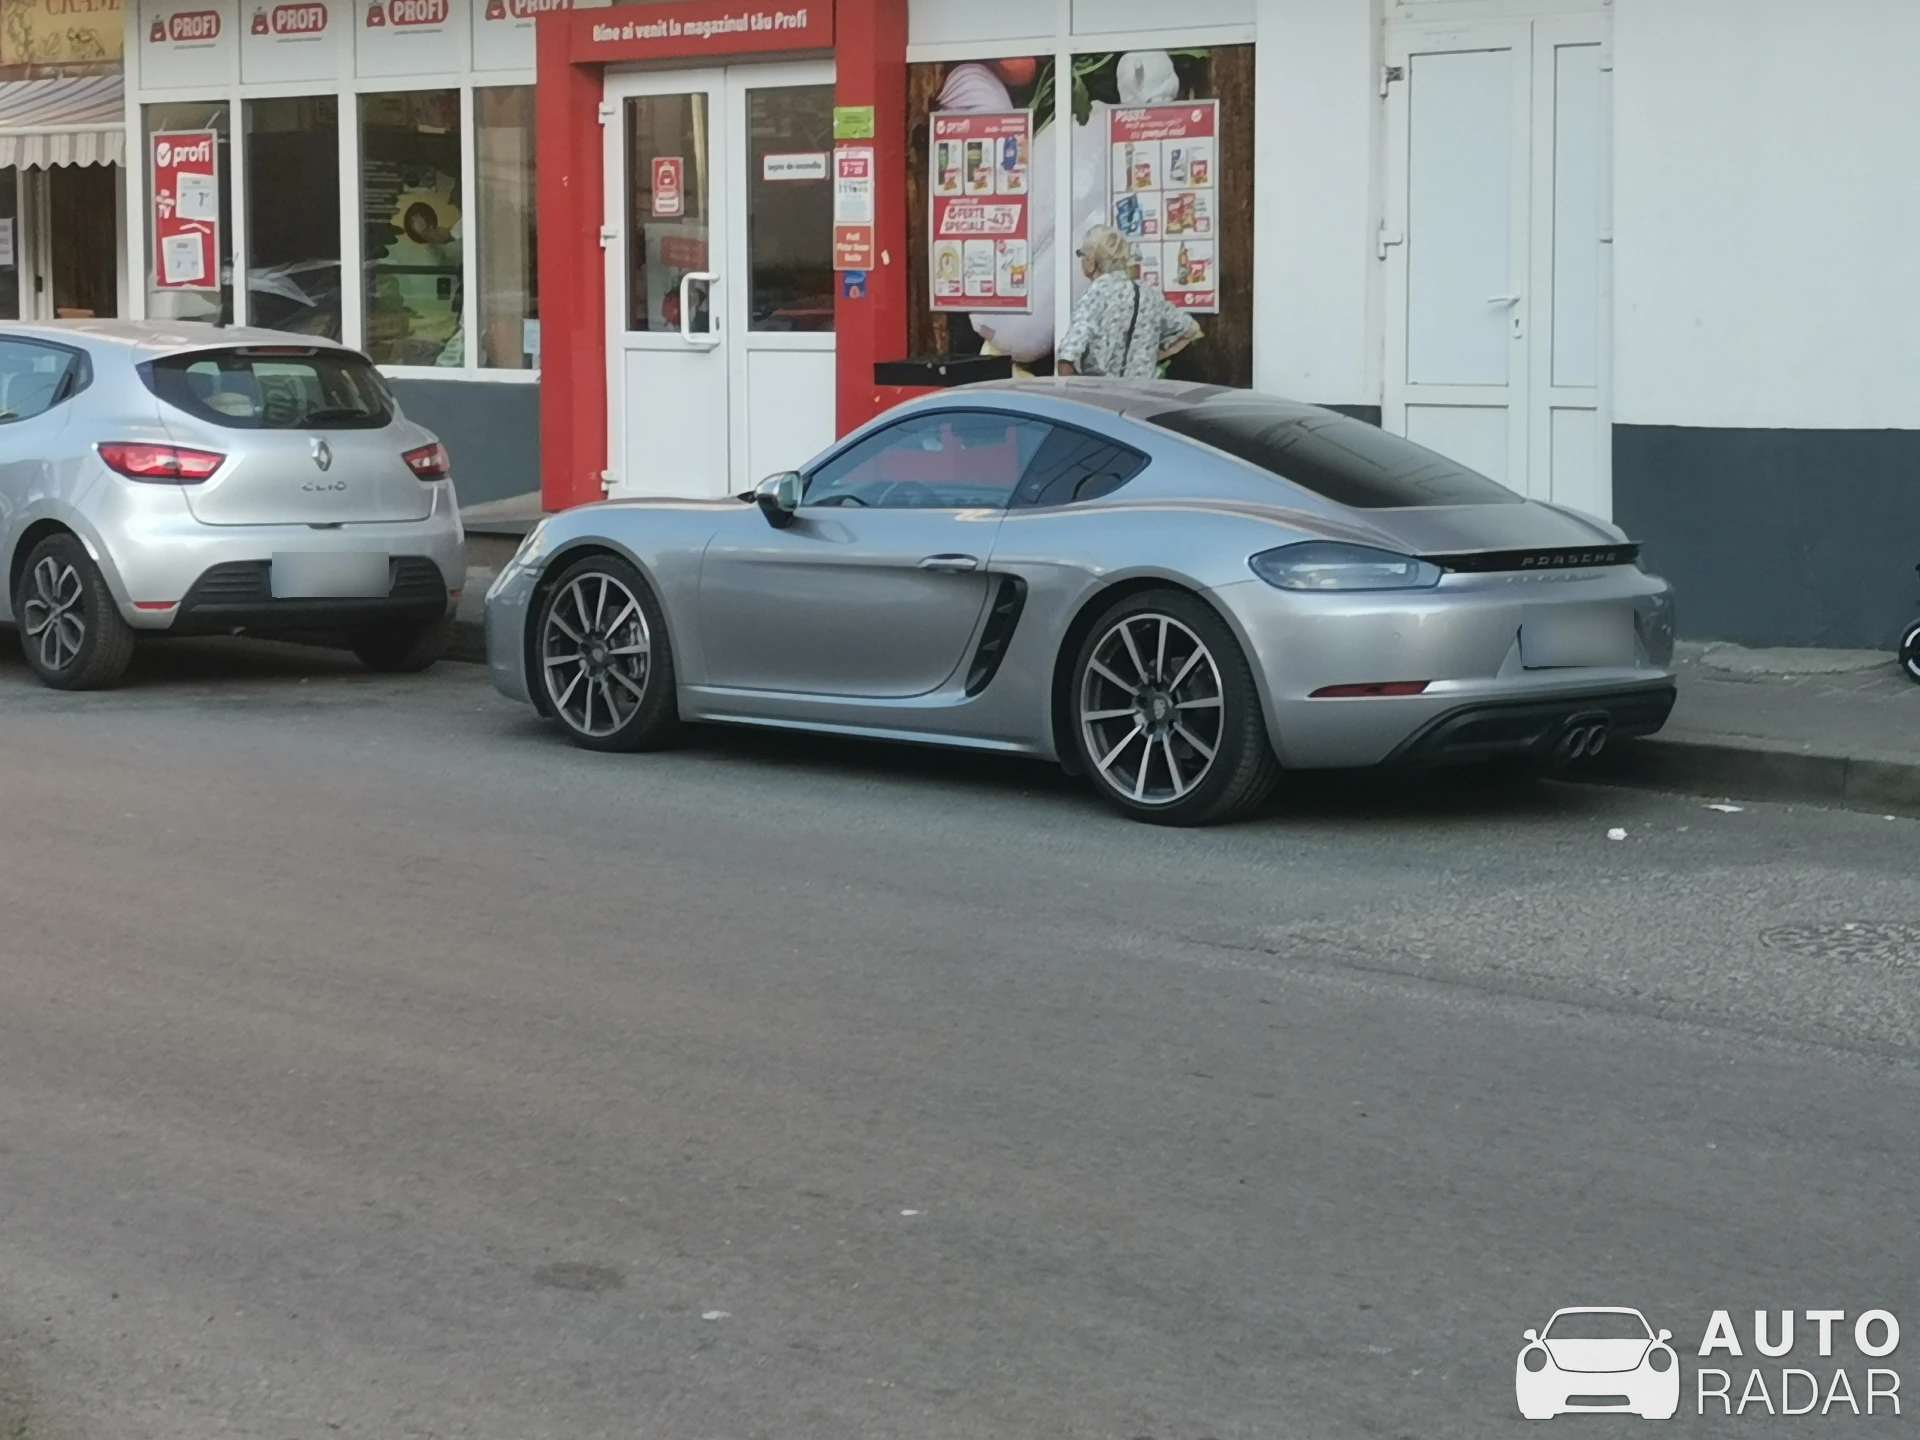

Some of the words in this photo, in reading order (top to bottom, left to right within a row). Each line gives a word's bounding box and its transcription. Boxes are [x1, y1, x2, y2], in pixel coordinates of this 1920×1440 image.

[276, 8, 323, 31] PROFI
[393, 0, 443, 22] PROFI
[173, 15, 216, 38] PROFI
[593, 23, 620, 42] Bine
[622, 21, 634, 40] ai
[636, 19, 667, 39] venit
[669, 18, 681, 37] la
[684, 13, 748, 39] magazinul
[775, 9, 807, 29] Profi
[172, 141, 210, 168] profi
[302, 481, 348, 491] CLIO
[1521, 552, 1617, 567] PORSCHE
